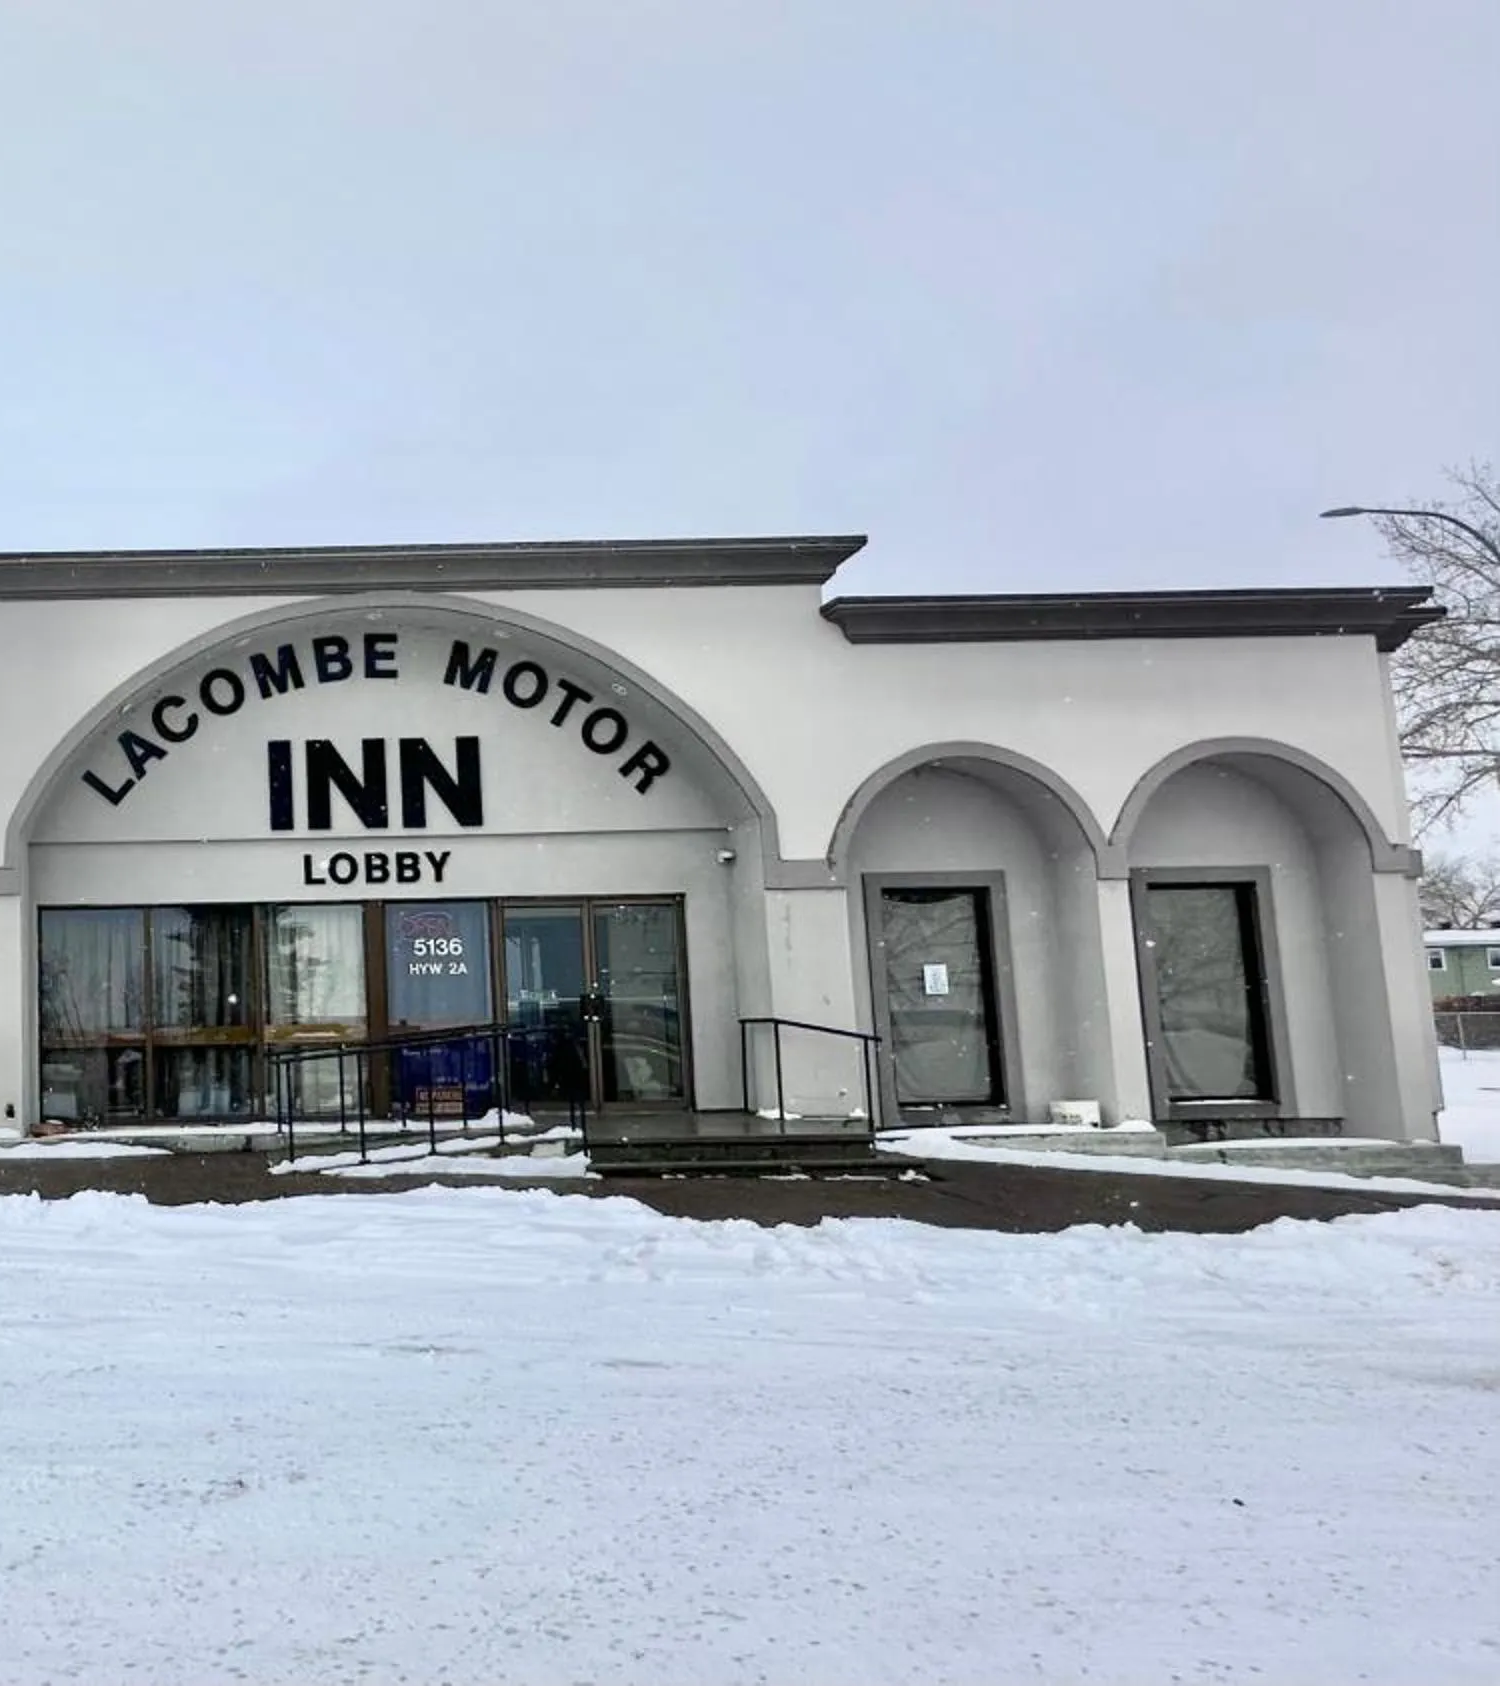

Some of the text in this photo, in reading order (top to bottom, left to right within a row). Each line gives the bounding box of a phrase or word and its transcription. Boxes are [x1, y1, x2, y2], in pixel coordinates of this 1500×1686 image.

[80, 631, 672, 807] LACOMBE MOTOR
[267, 735, 485, 832] INN
[303, 851, 452, 886] LOBBY
[412, 937, 464, 957] 5136
[408, 961, 469, 976] HYW 2A
